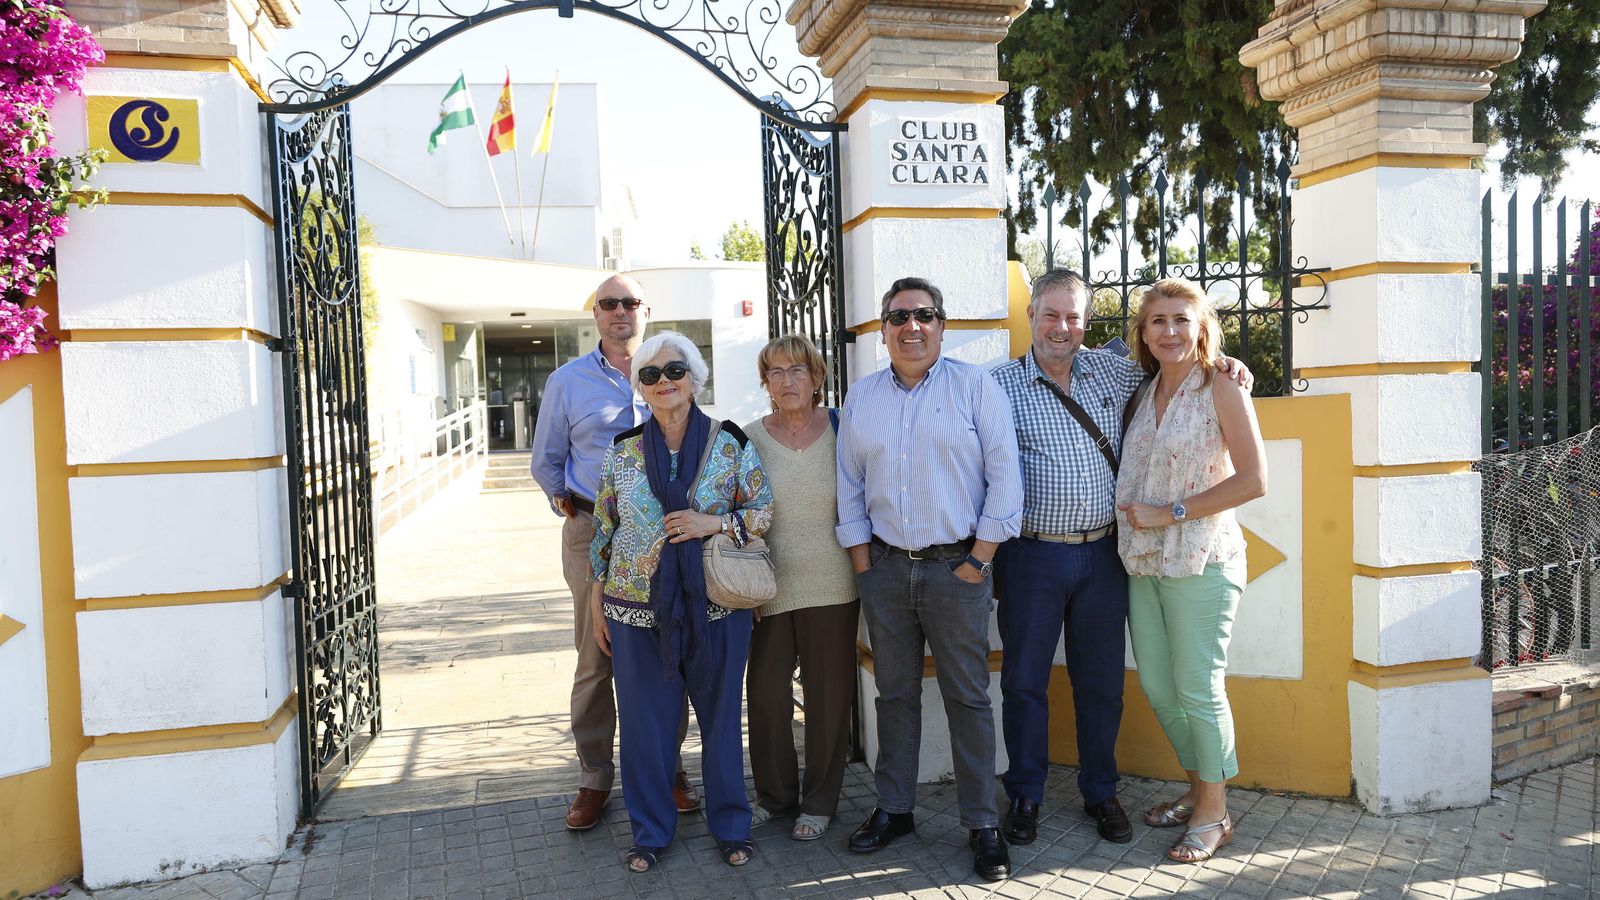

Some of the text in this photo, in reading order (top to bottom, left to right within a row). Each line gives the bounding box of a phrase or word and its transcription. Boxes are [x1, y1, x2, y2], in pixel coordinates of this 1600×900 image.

[901, 120, 977, 141] CLUB
[891, 142, 988, 162] SANTA
[892, 164, 988, 184] CLARA
